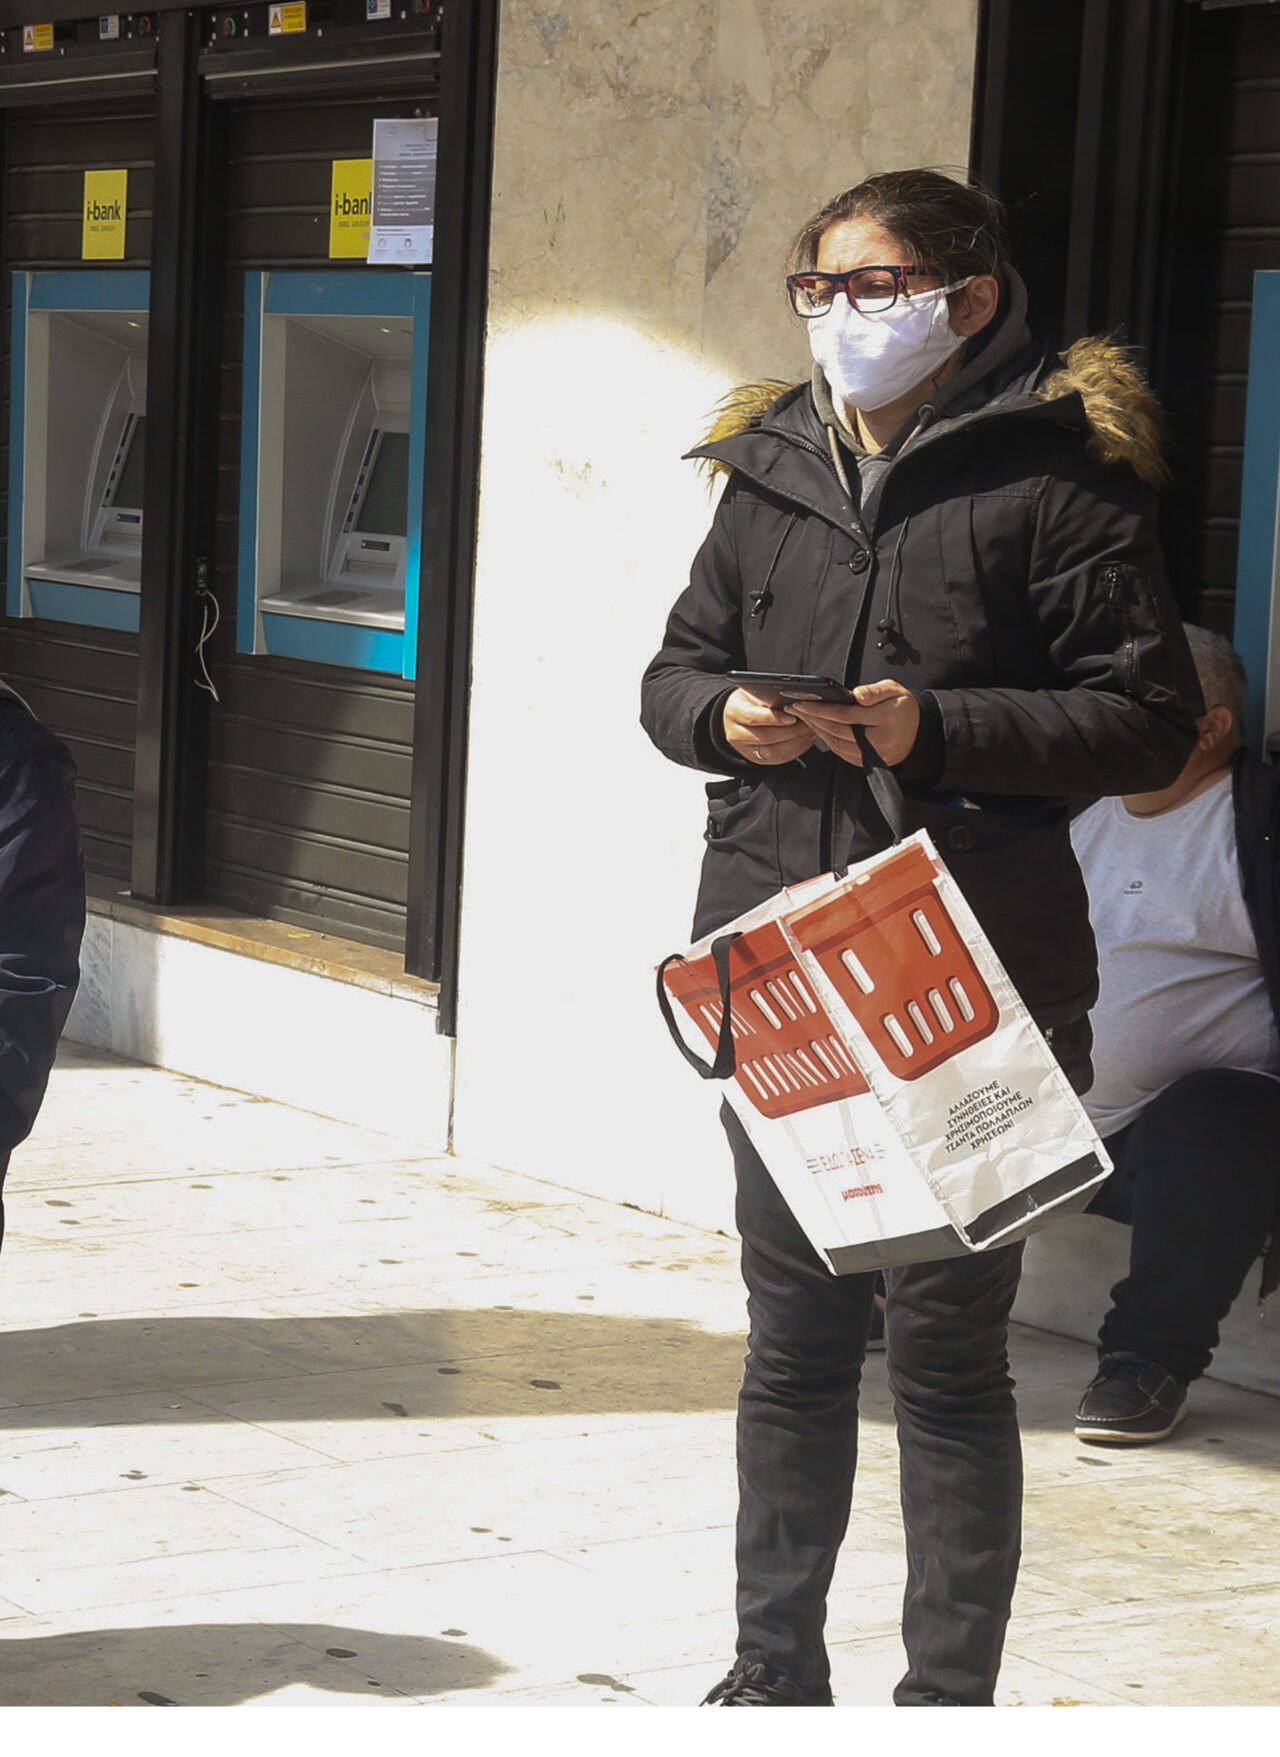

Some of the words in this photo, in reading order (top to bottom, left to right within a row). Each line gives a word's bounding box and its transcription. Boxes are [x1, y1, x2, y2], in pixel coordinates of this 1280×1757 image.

[87, 199, 121, 221] i-bank
[945, 1090, 1024, 1142] ΧΡΗΣΙΜΟΠΟΙΟΥΜΕ
[947, 1096, 994, 1128] ΣΥΝΗΘΕΙΕΣ
[993, 1086, 1011, 1101] ΚΑΙ
[948, 1080, 1000, 1116] ΑΛΛΑΖΟΥΜΕ
[945, 1130, 976, 1154] ΤΣΑΝΤΑ
[975, 1096, 1034, 1135] ΠΟΛΛΑΠΛΩΝ
[969, 1119, 1015, 1151] ΧΡΗΣΕΩΝ!
